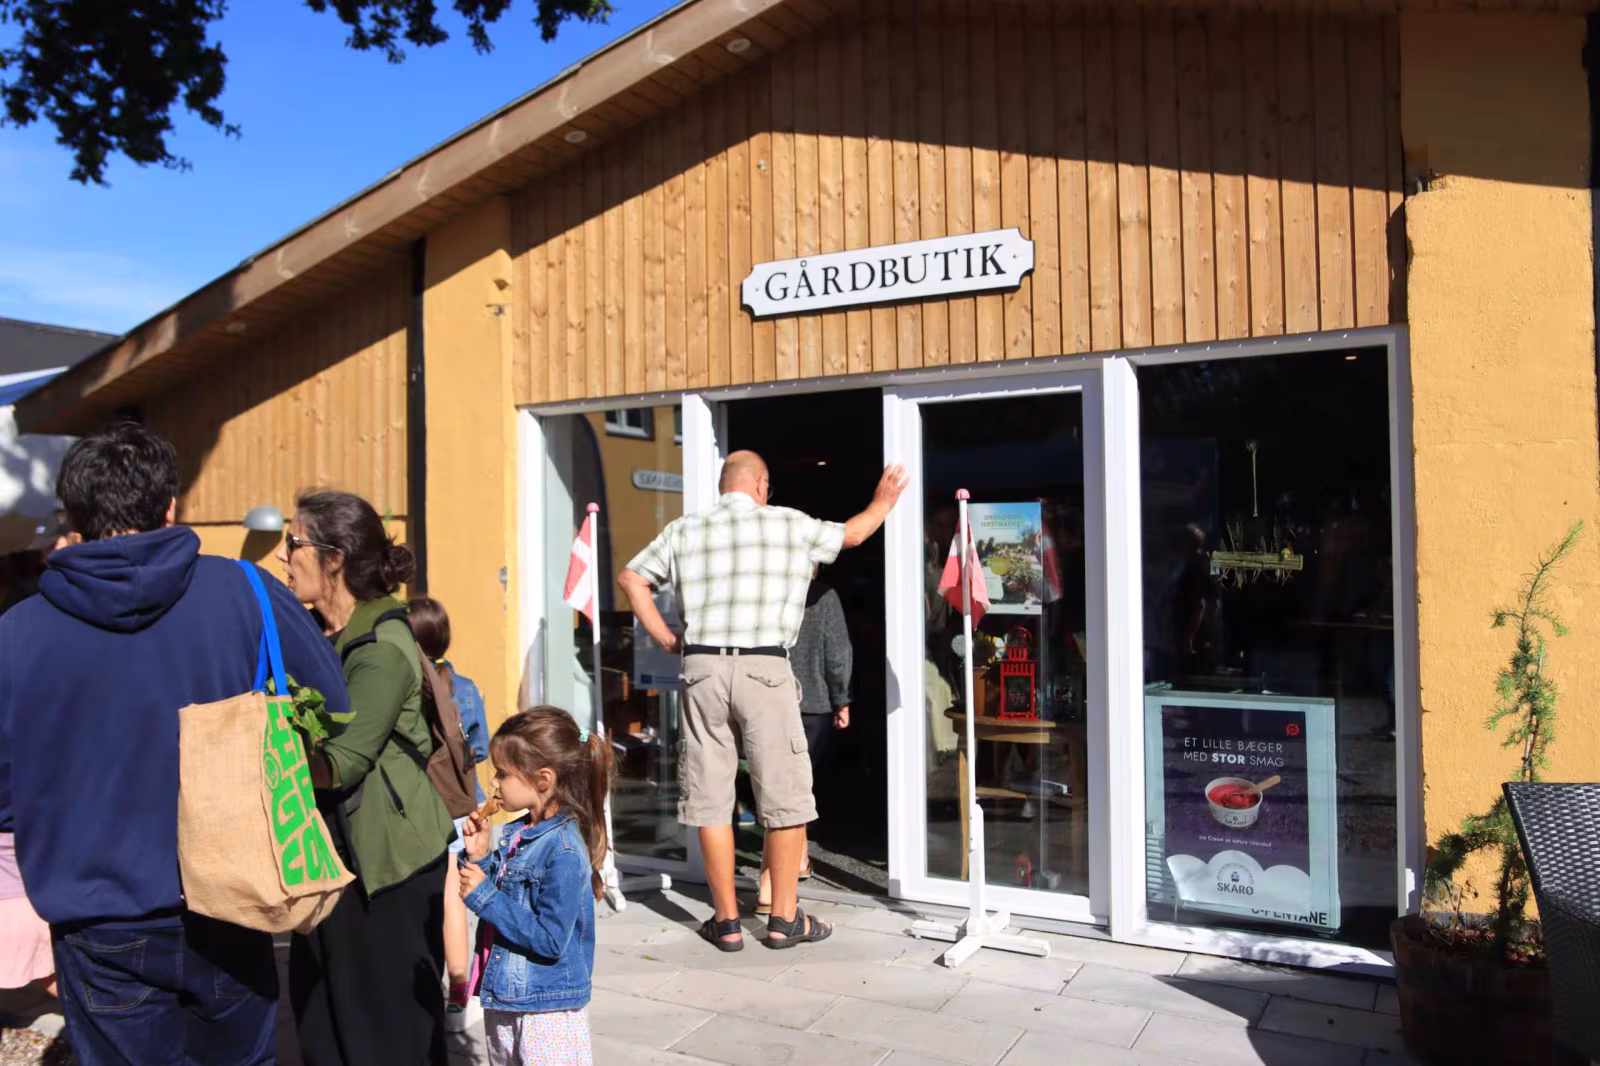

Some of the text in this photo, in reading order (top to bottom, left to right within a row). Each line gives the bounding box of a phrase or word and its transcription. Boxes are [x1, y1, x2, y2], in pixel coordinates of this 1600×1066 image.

[765, 244, 1006, 301] GÅRDBUTIK
[1184, 737, 1283, 753] ET LILLE BÆGER
[1183, 751, 1284, 767] MED STOR SMAG
[1217, 882, 1254, 895] SKARØ
